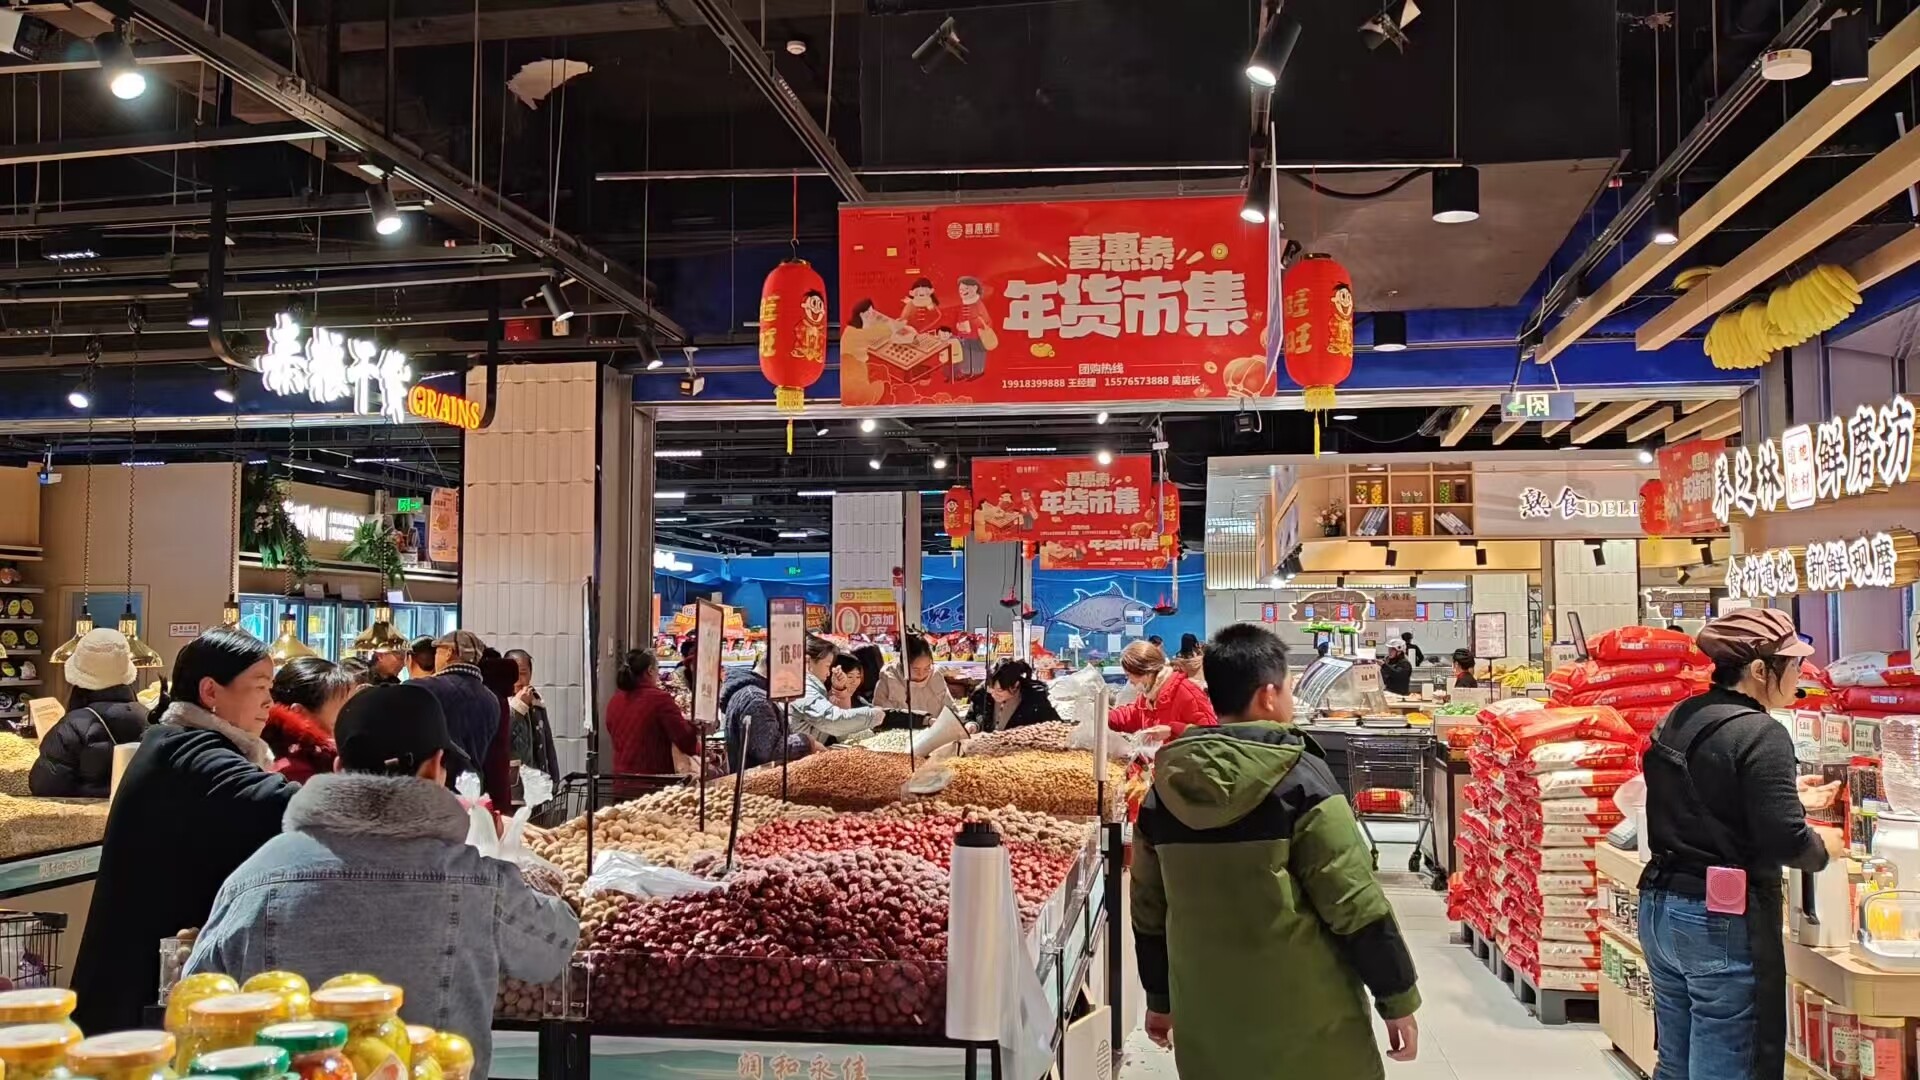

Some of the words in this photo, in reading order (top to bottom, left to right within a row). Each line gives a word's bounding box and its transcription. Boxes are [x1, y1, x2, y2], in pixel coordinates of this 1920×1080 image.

[965, 222, 993, 235] 喜惠泰
[1068, 232, 1175, 272] 喜惠泰
[1003, 270, 1249, 338] 年货市集
[1002, 379, 1066, 389] 19918399888
[1067, 377, 1097, 388] 王经理
[1104, 376, 1169, 387] 15576573888
[1171, 375, 1201, 386] 吴店长
[1078, 363, 1125, 375] 团购热线
[408, 386, 480, 430] GRAINS
[1713, 439, 1785, 523] 养芝林
[1816, 395, 1915, 499] 鲜磨坊
[1066, 471, 1110, 488] 喜惠泰
[1040, 487, 1140, 514] 年货市集
[1519, 485, 1588, 520] 熟食
[1585, 499, 1640, 517] DELI
[1725, 550, 1798, 599] 食材道地
[1806, 532, 1897, 590] 新鲜现磨
[860, 612, 895, 627] 0添加
[739, 1051, 870, 1080] 润和永佳
